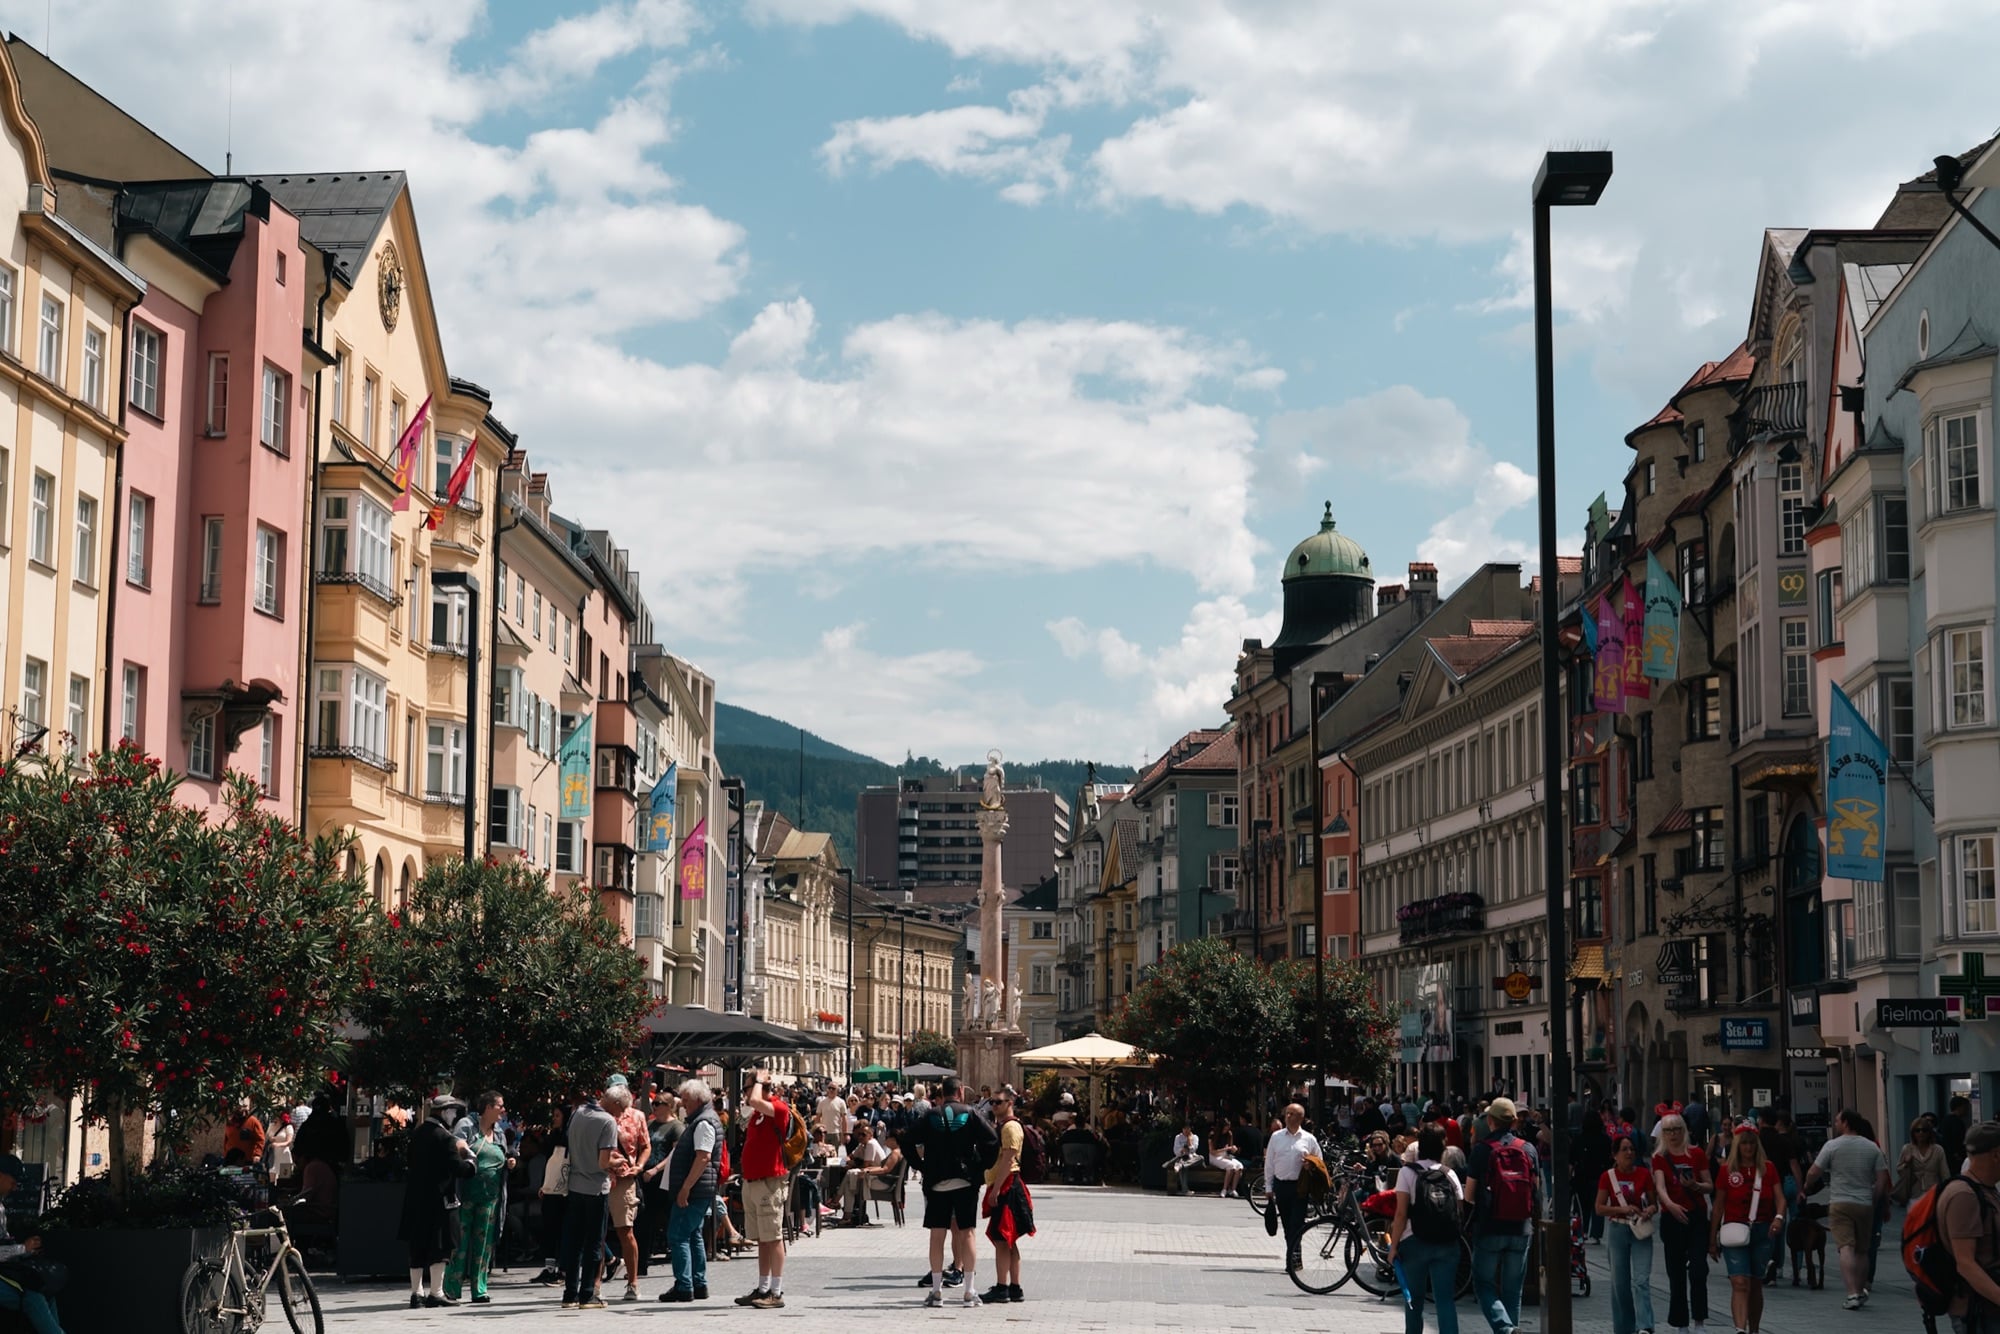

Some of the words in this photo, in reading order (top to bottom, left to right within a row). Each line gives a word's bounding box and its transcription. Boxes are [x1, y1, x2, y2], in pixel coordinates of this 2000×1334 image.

[1881, 1004, 1946, 1022] fielman
[1726, 1038, 1764, 1046] INNSBRUCK
[1785, 1048, 1822, 1058] NORZ
